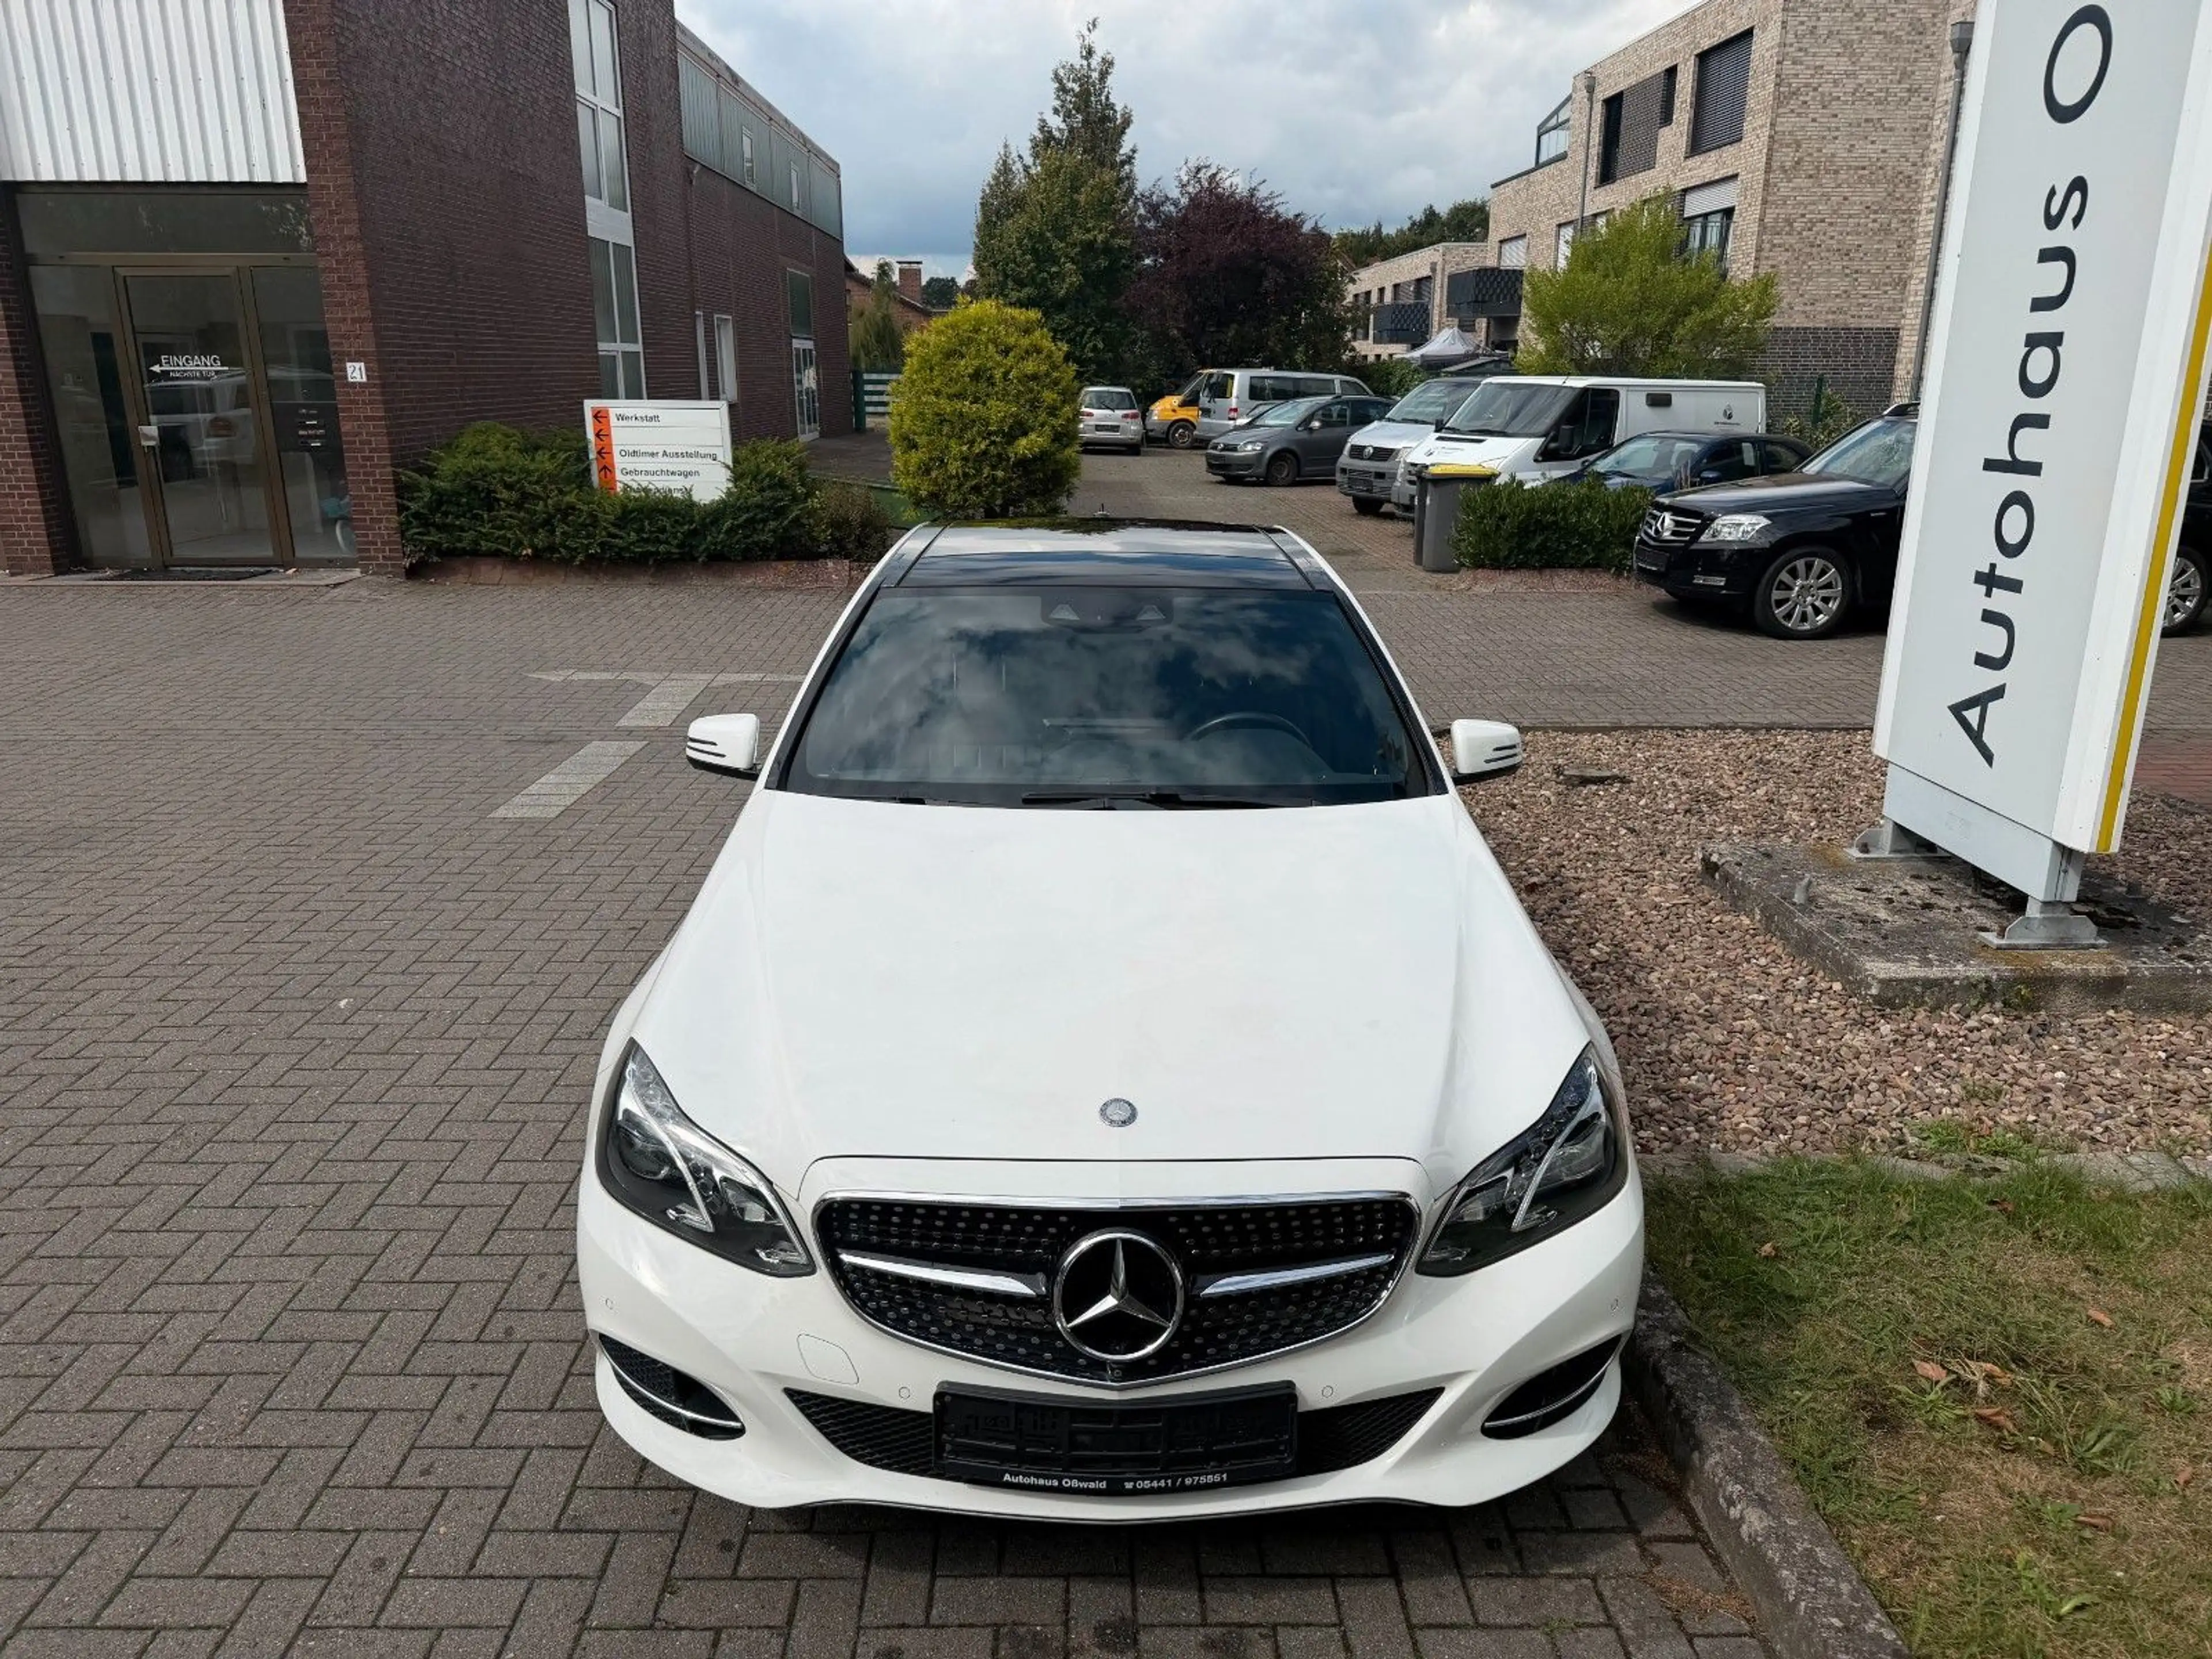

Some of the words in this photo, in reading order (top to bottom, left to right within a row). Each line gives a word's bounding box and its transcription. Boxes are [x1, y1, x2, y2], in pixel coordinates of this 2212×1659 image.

[161, 354, 221, 366] EINGANG
[349, 364, 364, 380] 21
[1947, 175, 2089, 768] Autohaus
[2043, 4, 2113, 124] O
[615, 413, 661, 423] Werkstatt
[619, 449, 660, 459] Oldtimer
[662, 450, 718, 461] Ausstellung
[620, 467, 700, 479] Gebrauchtwagen
[1003, 1473, 1059, 1486] Autohaus
[1062, 1478, 1107, 1489] Oßwald
